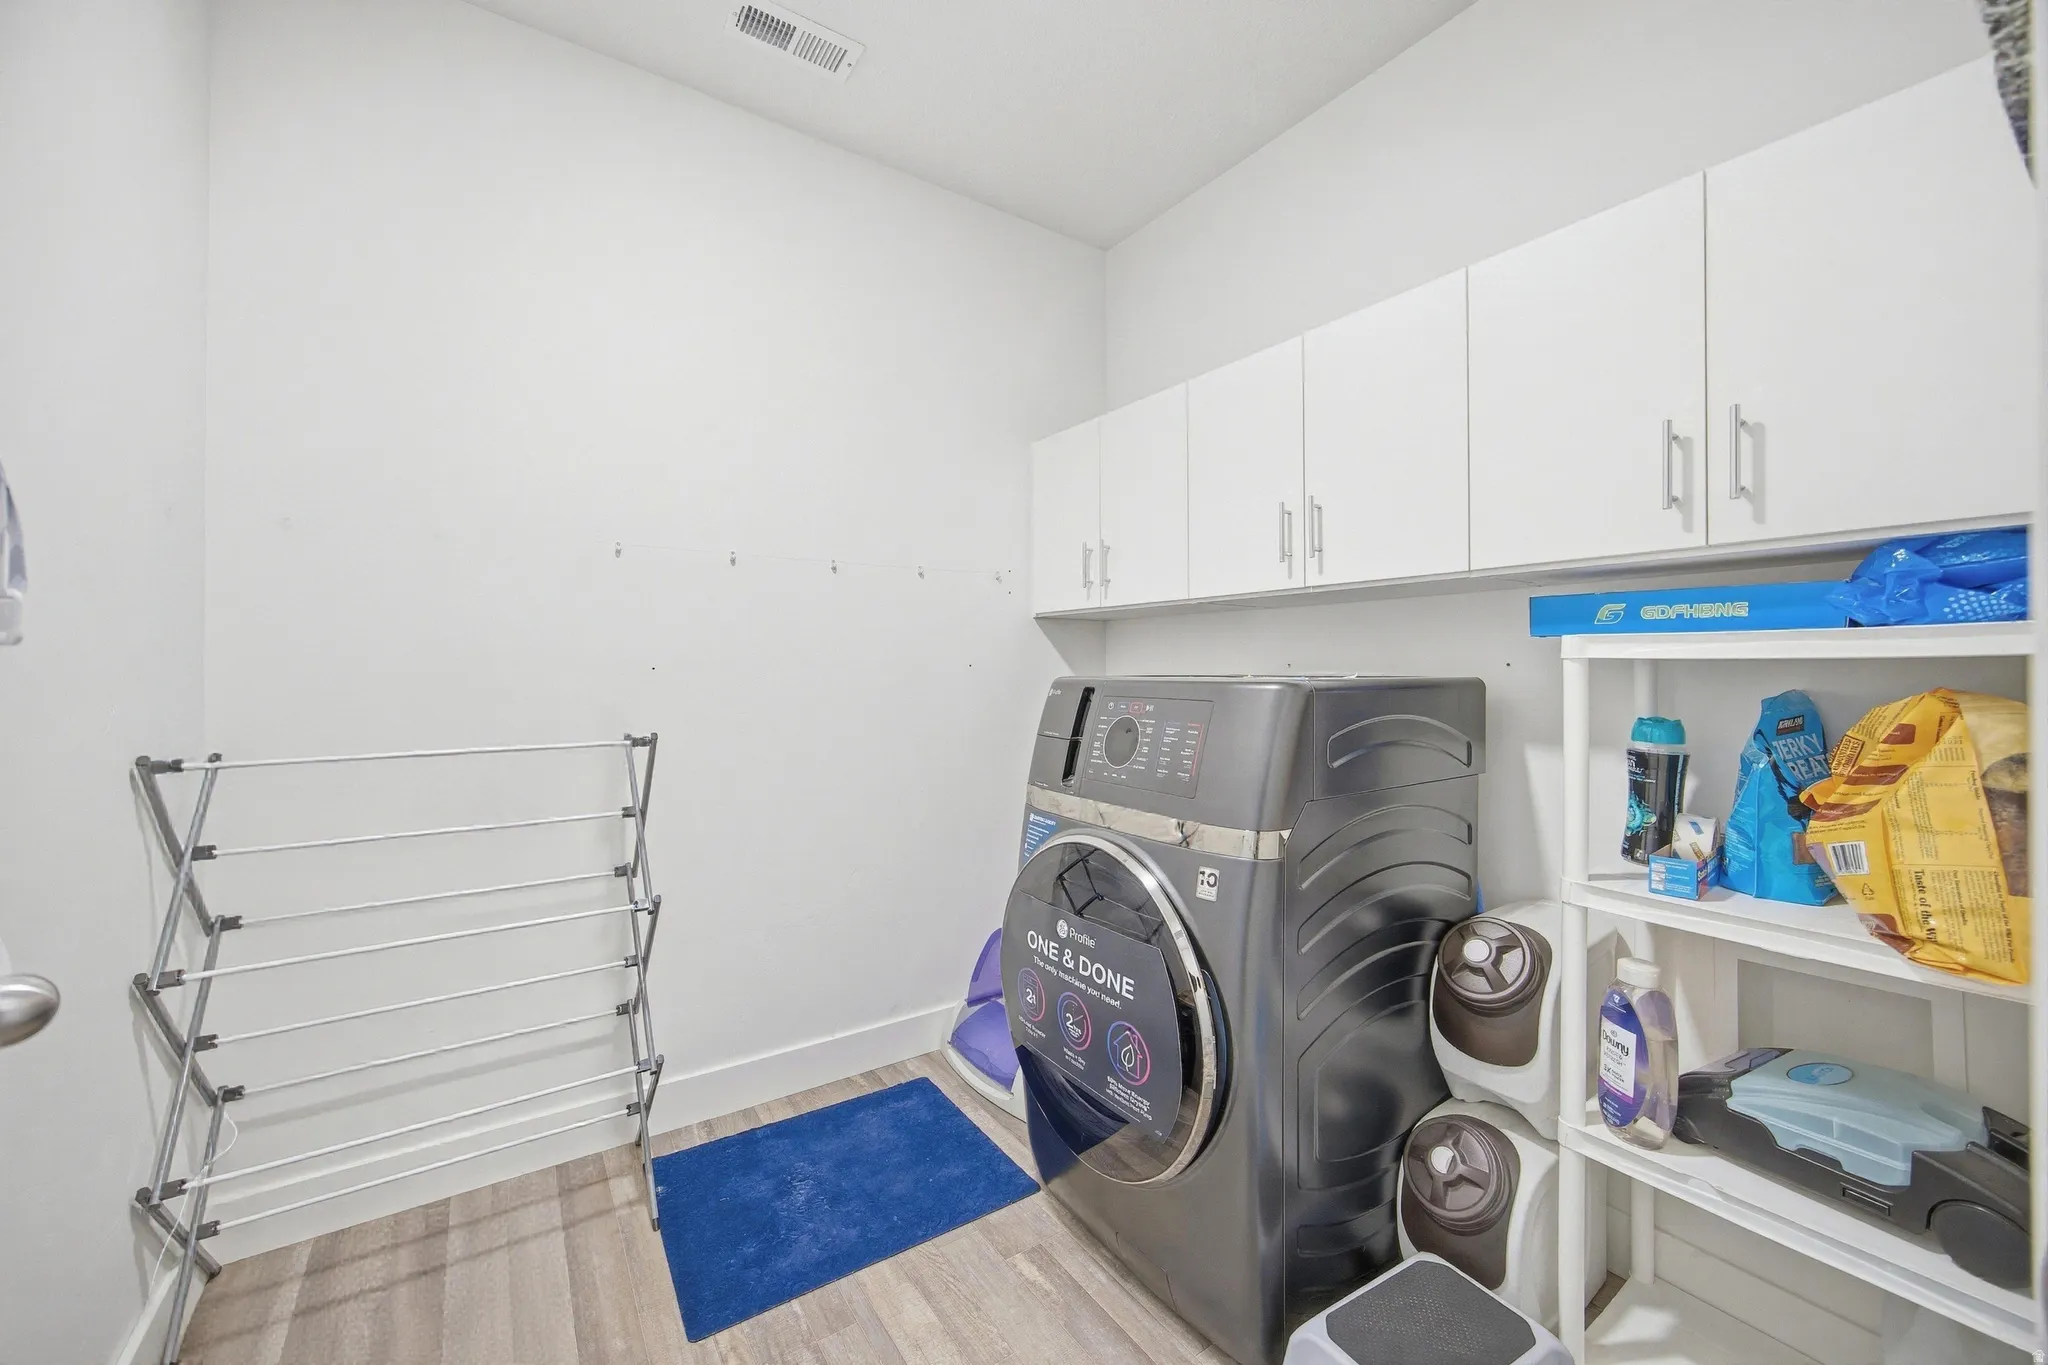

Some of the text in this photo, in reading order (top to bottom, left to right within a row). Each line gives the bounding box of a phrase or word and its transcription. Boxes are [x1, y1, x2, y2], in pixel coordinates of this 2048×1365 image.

[1772, 733, 1823, 760] JERKY
[1786, 754, 1832, 781] REAT
[1914, 869, 1926, 895] Taste
[1920, 898, 1931, 908] of
[1921, 910, 1932, 925] the
[1069, 927, 1096, 948] Profile
[1027, 930, 1135, 1000] ONE & DONE
[1033, 955, 1122, 1010] The only machine you need.
[1602, 1028, 1630, 1057] Downy
